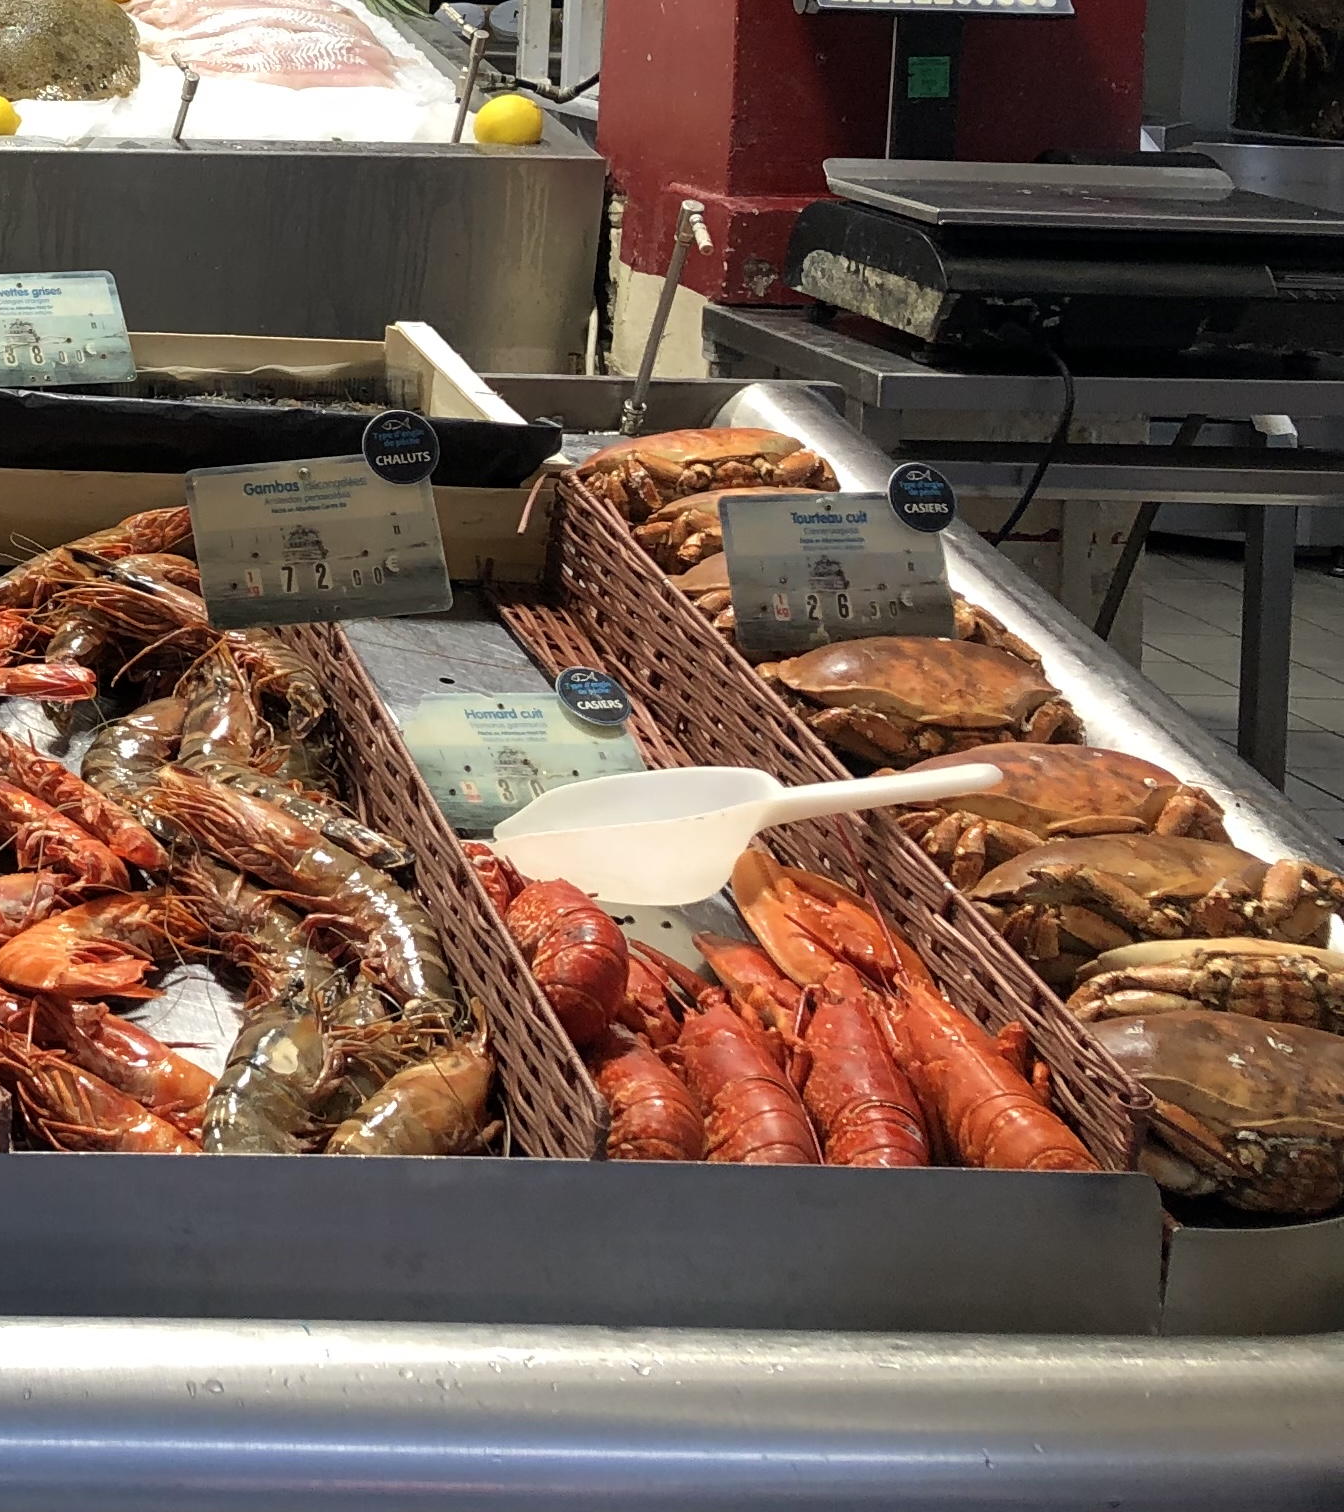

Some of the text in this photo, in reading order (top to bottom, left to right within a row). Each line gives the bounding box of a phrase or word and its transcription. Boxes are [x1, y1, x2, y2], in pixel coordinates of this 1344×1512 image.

[31, 287, 62, 299] grises
[375, 451, 431, 467] CHALUTS
[243, 479, 300, 496] Gambas
[904, 503, 949, 514] CASIERS
[790, 512, 868, 525] Tourteau cuit
[576, 698, 623, 709] CASIERS
[464, 708, 544, 720] Homard cuit
